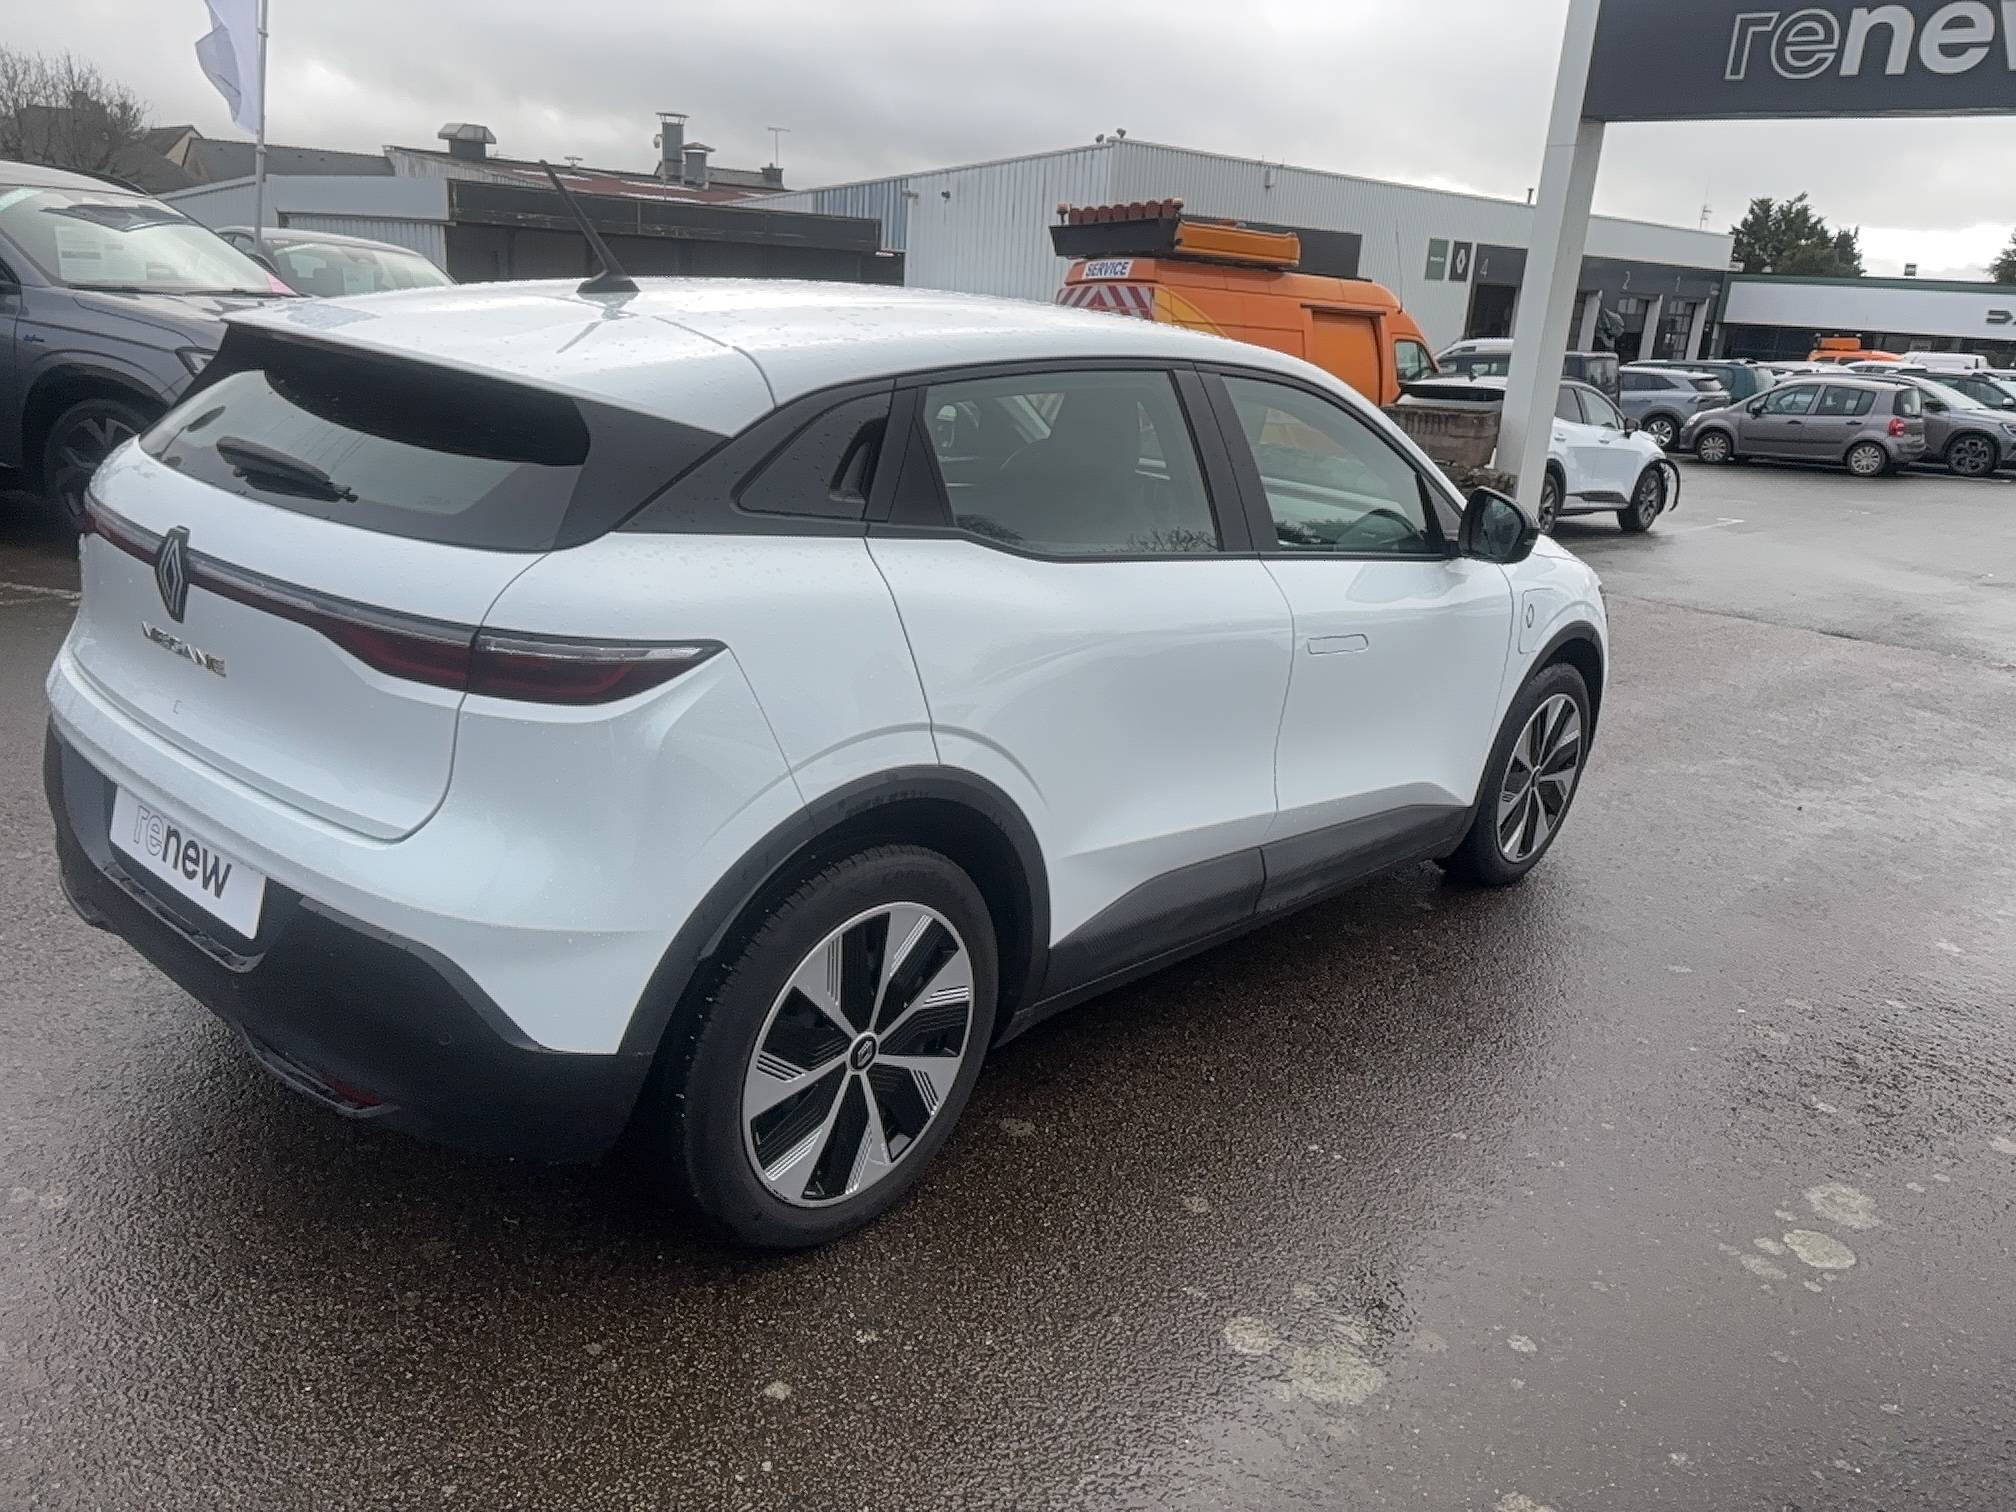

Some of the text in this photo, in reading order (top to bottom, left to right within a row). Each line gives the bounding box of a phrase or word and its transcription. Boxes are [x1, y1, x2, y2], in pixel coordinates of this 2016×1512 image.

[1723, 0, 2016, 81] rene
[1085, 260, 1129, 277] SERVICE
[1480, 258, 1489, 279] 4
[1622, 271, 1631, 290] 2
[133, 805, 232, 899] renew
